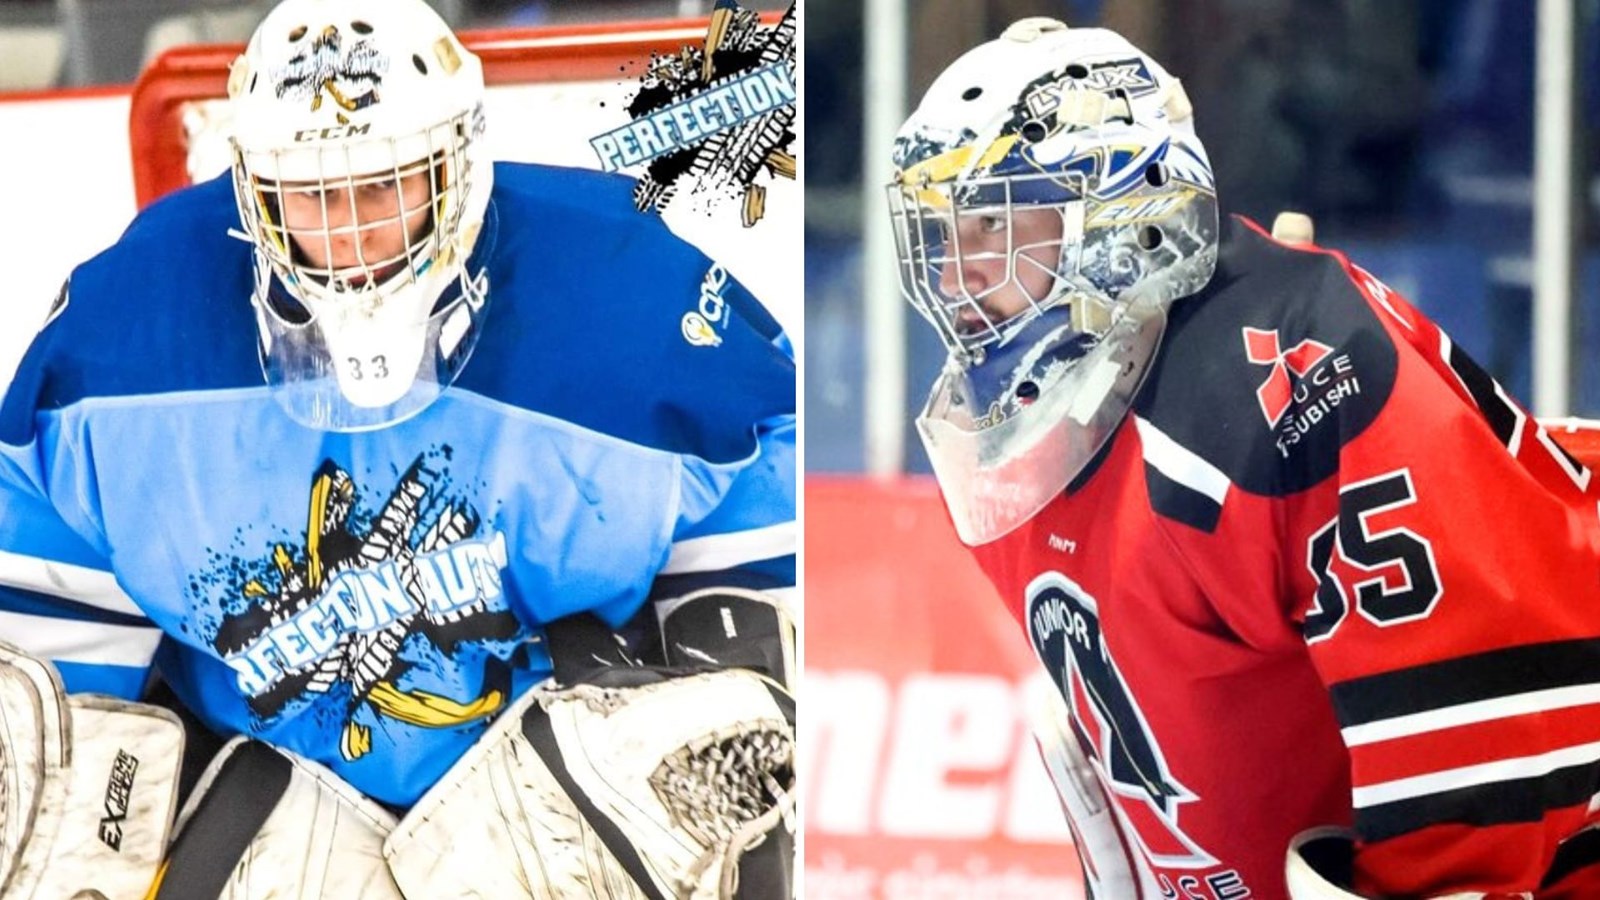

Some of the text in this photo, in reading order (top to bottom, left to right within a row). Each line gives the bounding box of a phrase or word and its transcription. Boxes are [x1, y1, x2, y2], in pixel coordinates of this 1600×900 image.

[1026, 62, 1158, 120] LYNX
[294, 122, 371, 142] CCM
[347, 354, 389, 381] 33
[1034, 597, 1091, 651] JUNIOR
[97, 748, 133, 853] EXTREME
